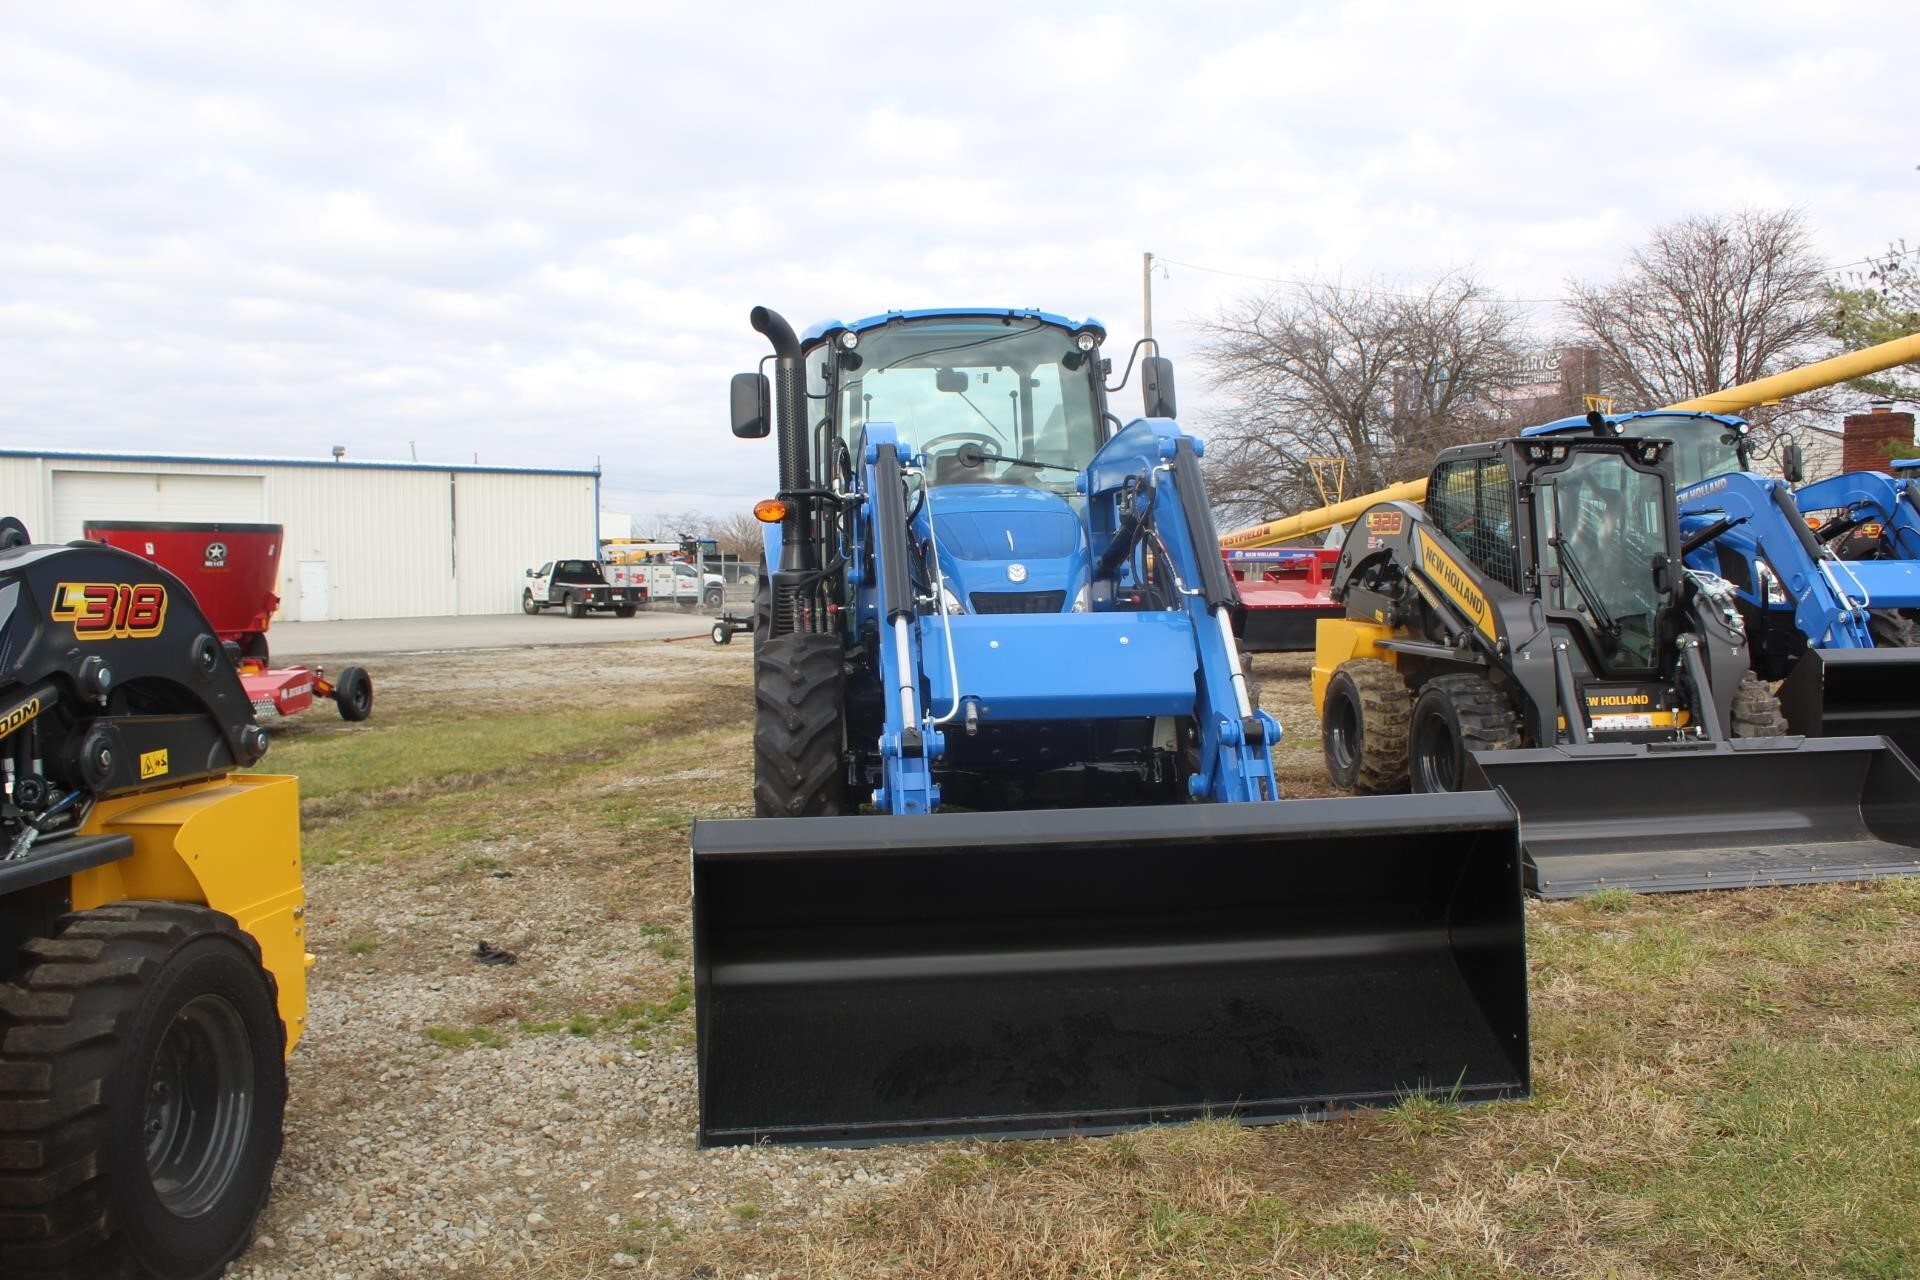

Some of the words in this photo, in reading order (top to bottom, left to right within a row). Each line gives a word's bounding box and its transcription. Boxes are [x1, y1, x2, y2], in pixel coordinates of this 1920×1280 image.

[1690, 478, 1727, 500] HOLLAND
[1425, 545, 1445, 575] NEW
[1444, 566, 1483, 615] HOLLAND
[51, 583, 168, 640] L318
[0, 698, 39, 738] OOM
[1600, 695, 1649, 706] HOLLAND
